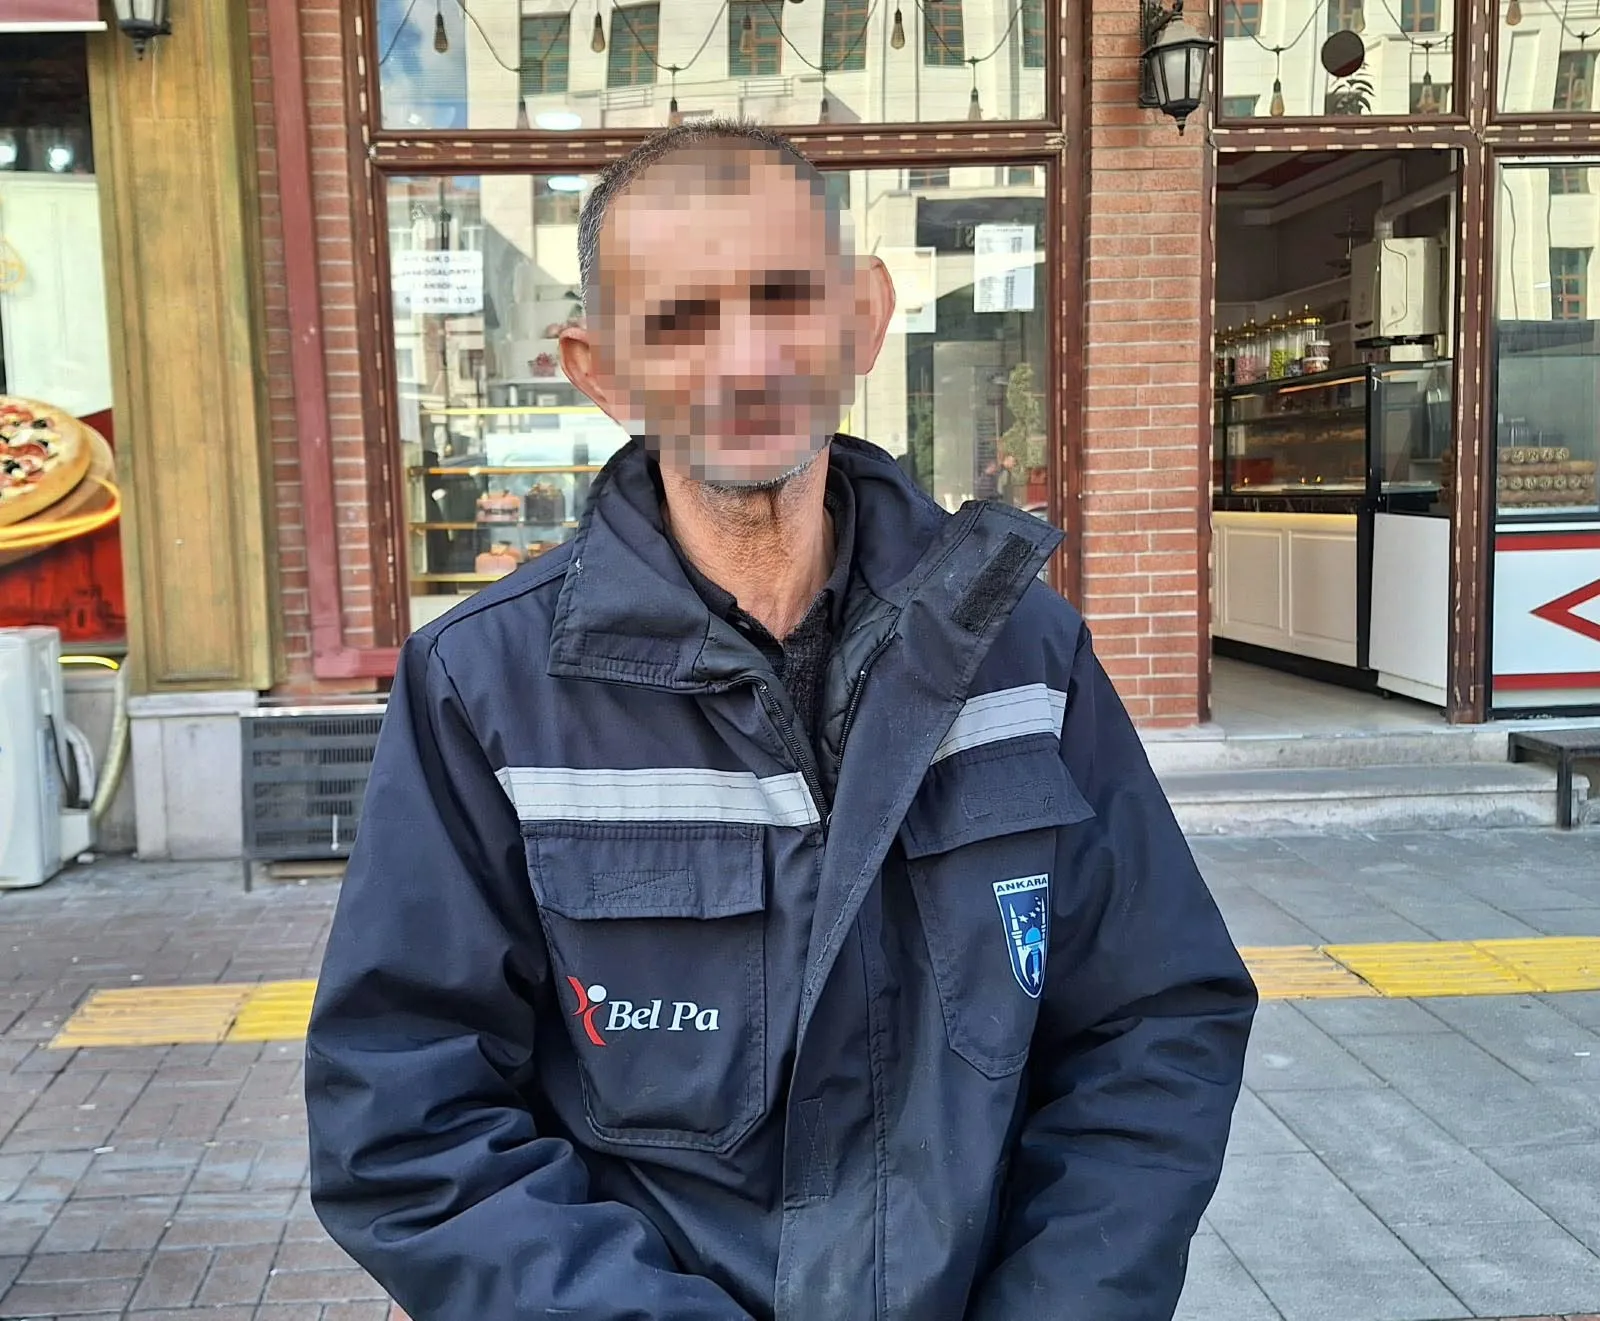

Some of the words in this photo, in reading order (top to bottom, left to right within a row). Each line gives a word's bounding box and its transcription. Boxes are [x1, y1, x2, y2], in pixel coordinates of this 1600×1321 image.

[996, 876, 1048, 893] ANKARA
[605, 999, 662, 1031] Bel
[667, 1001, 720, 1031] Pa
